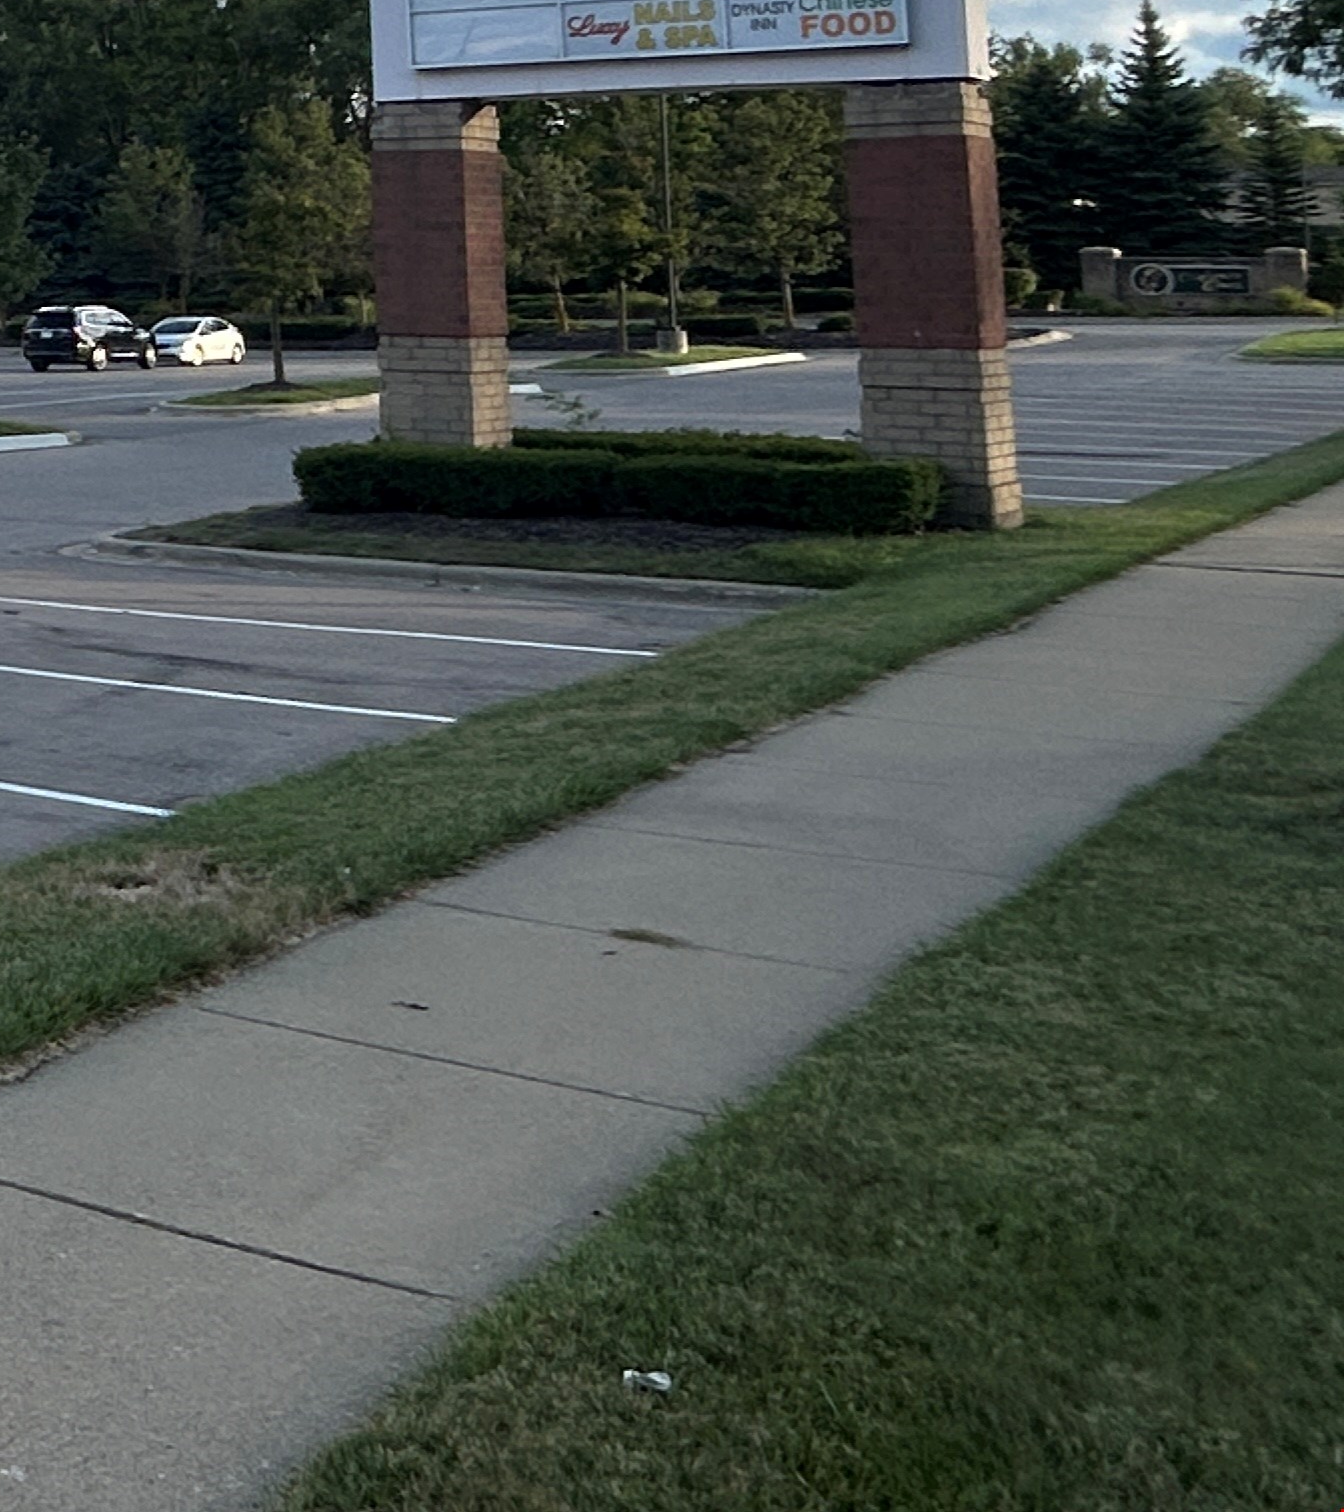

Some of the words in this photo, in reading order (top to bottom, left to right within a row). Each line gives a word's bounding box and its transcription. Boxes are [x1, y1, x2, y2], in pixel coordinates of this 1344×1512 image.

[731, 0, 795, 18] DYNASTY
[636, 28, 656, 50] &
[664, 24, 719, 49] SPA
[799, 10, 896, 39] FOOD
